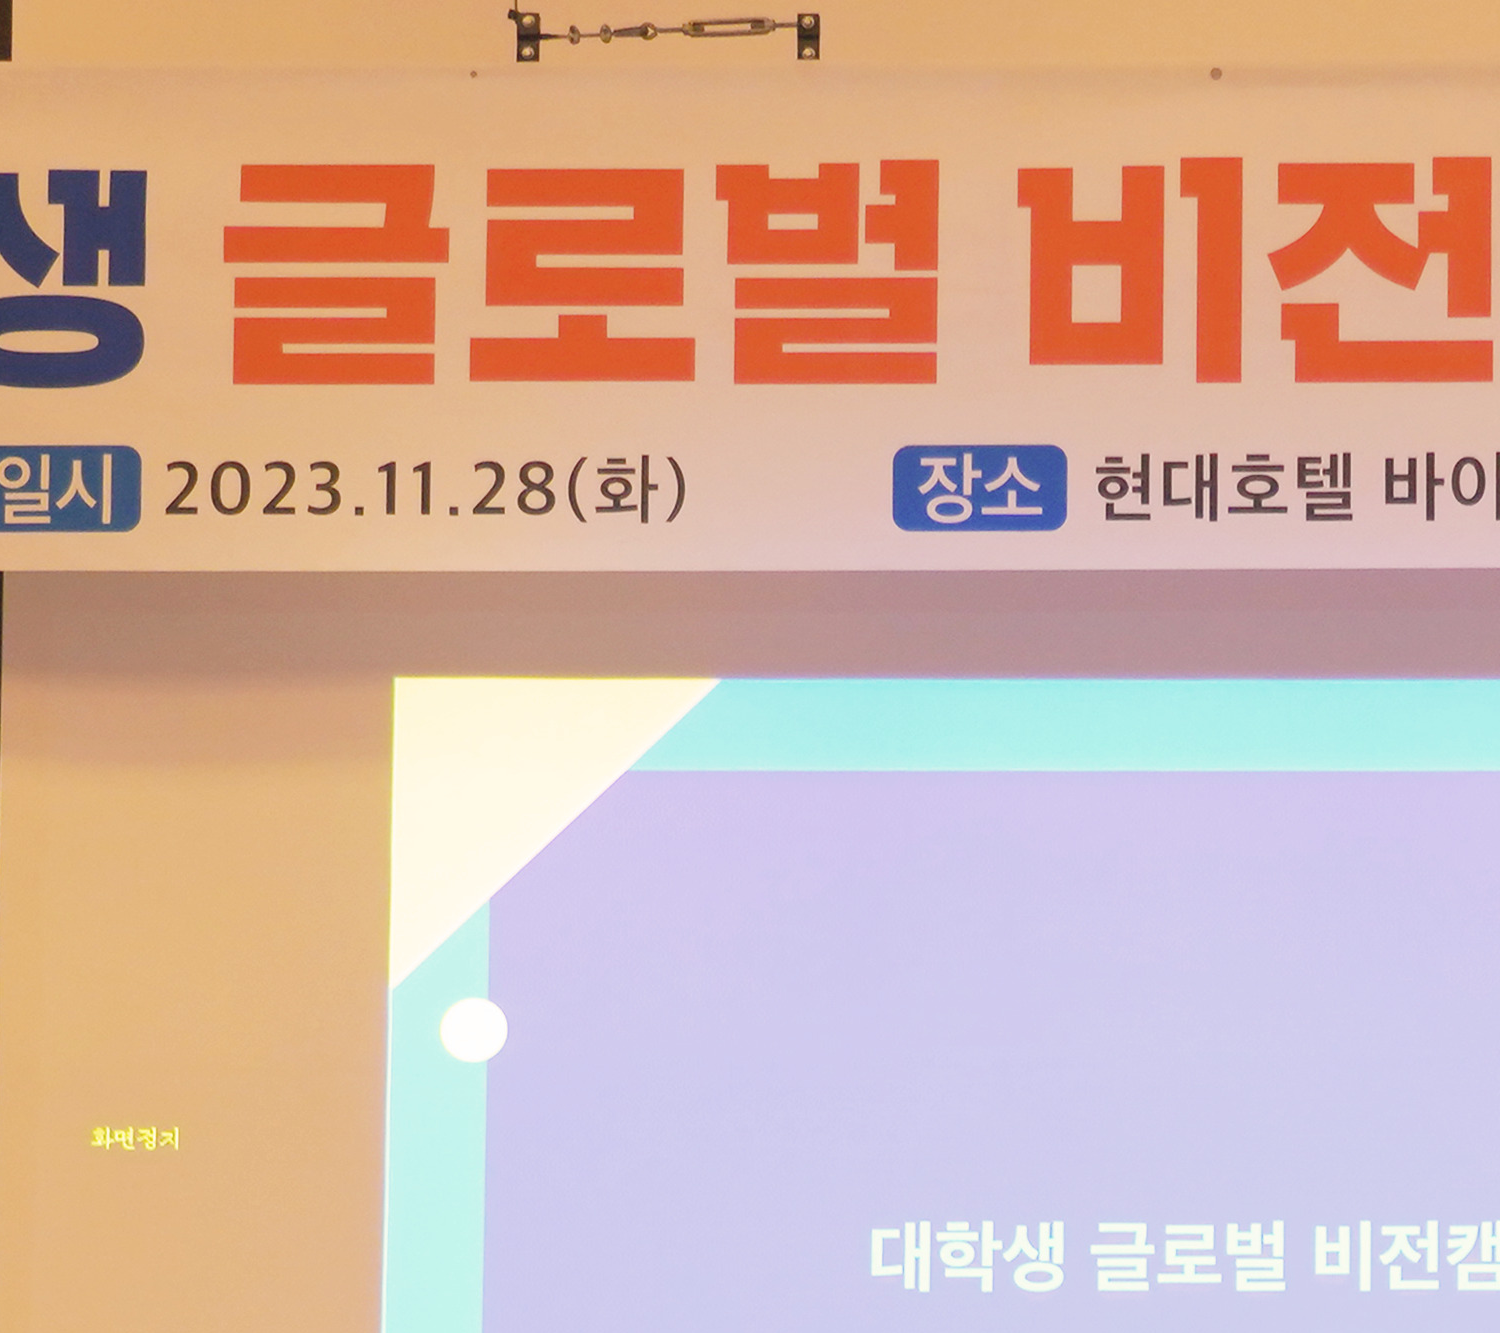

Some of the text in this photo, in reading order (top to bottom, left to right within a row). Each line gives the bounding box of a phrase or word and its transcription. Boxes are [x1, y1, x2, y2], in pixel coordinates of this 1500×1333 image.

[223, 159, 939, 385] 글로벌
[165, 455, 685, 523] 2023.11.28(화)
[918, 453, 1039, 528] 장소
[1096, 452, 1353, 522] 현대호텔
[871, 1221, 1064, 1292] 대학생
[1090, 1220, 1285, 1291] 글로벌
